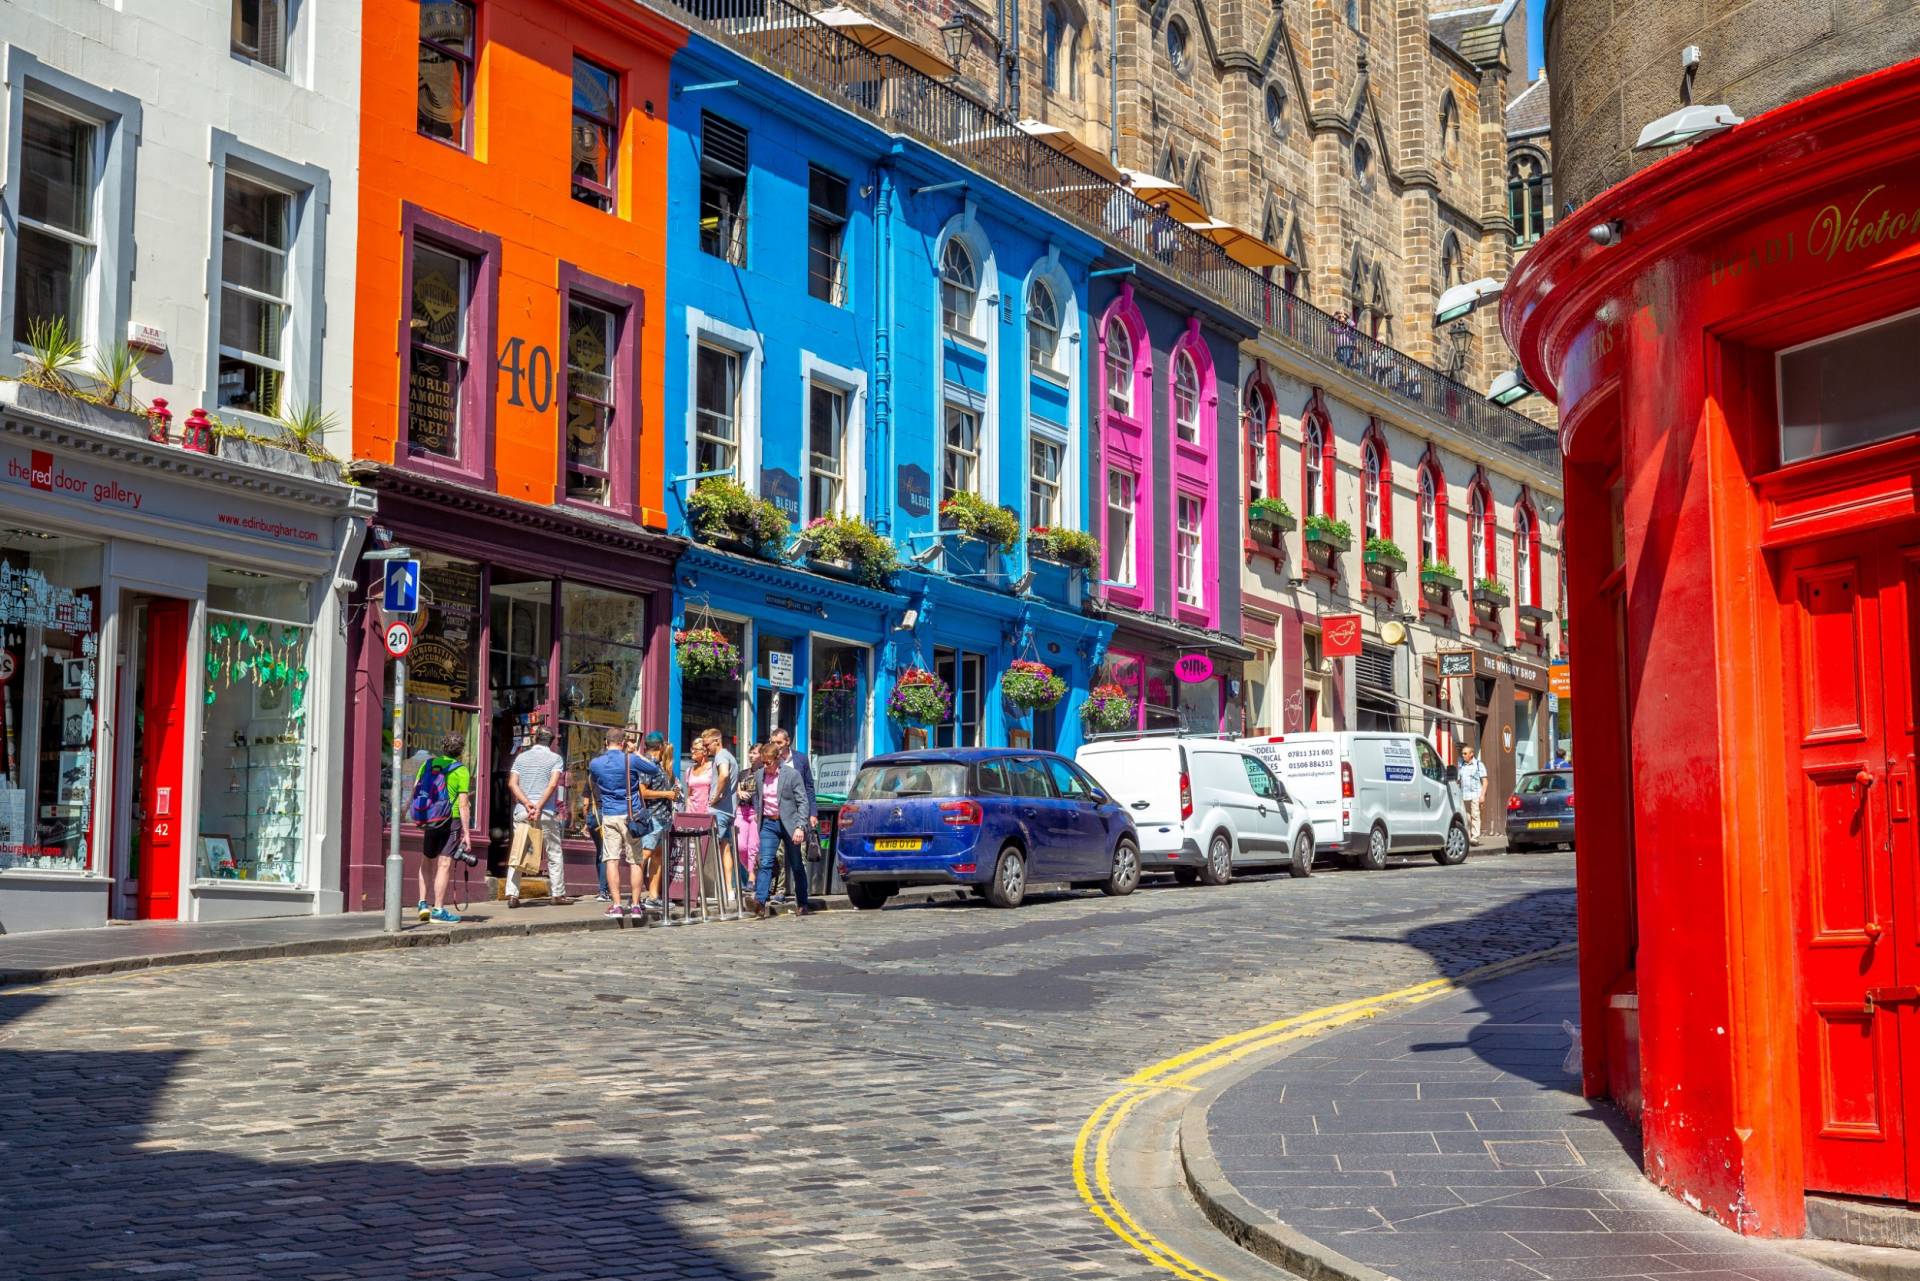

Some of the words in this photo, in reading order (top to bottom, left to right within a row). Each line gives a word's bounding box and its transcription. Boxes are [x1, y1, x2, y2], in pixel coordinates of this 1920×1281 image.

[410, 373, 450, 394] WORLD
[497, 336, 552, 413] 40
[410, 389, 454, 409] AMOUS!
[409, 402, 455, 423] DMISSION
[410, 416, 448, 438] FREE!
[8, 458, 30, 480] the
[31, 465, 52, 486] red
[55, 468, 87, 493] door
[94, 481, 142, 509] gallery
[775, 496, 799, 513] BLEUE
[911, 493, 931, 509] BLEUE
[218, 512, 319, 542] www.edinburghart.com
[390, 632, 407, 646] 20
[1484, 657, 1495, 670] THE
[1521, 668, 1536, 681] SHOP
[155, 824, 168, 835] 42
